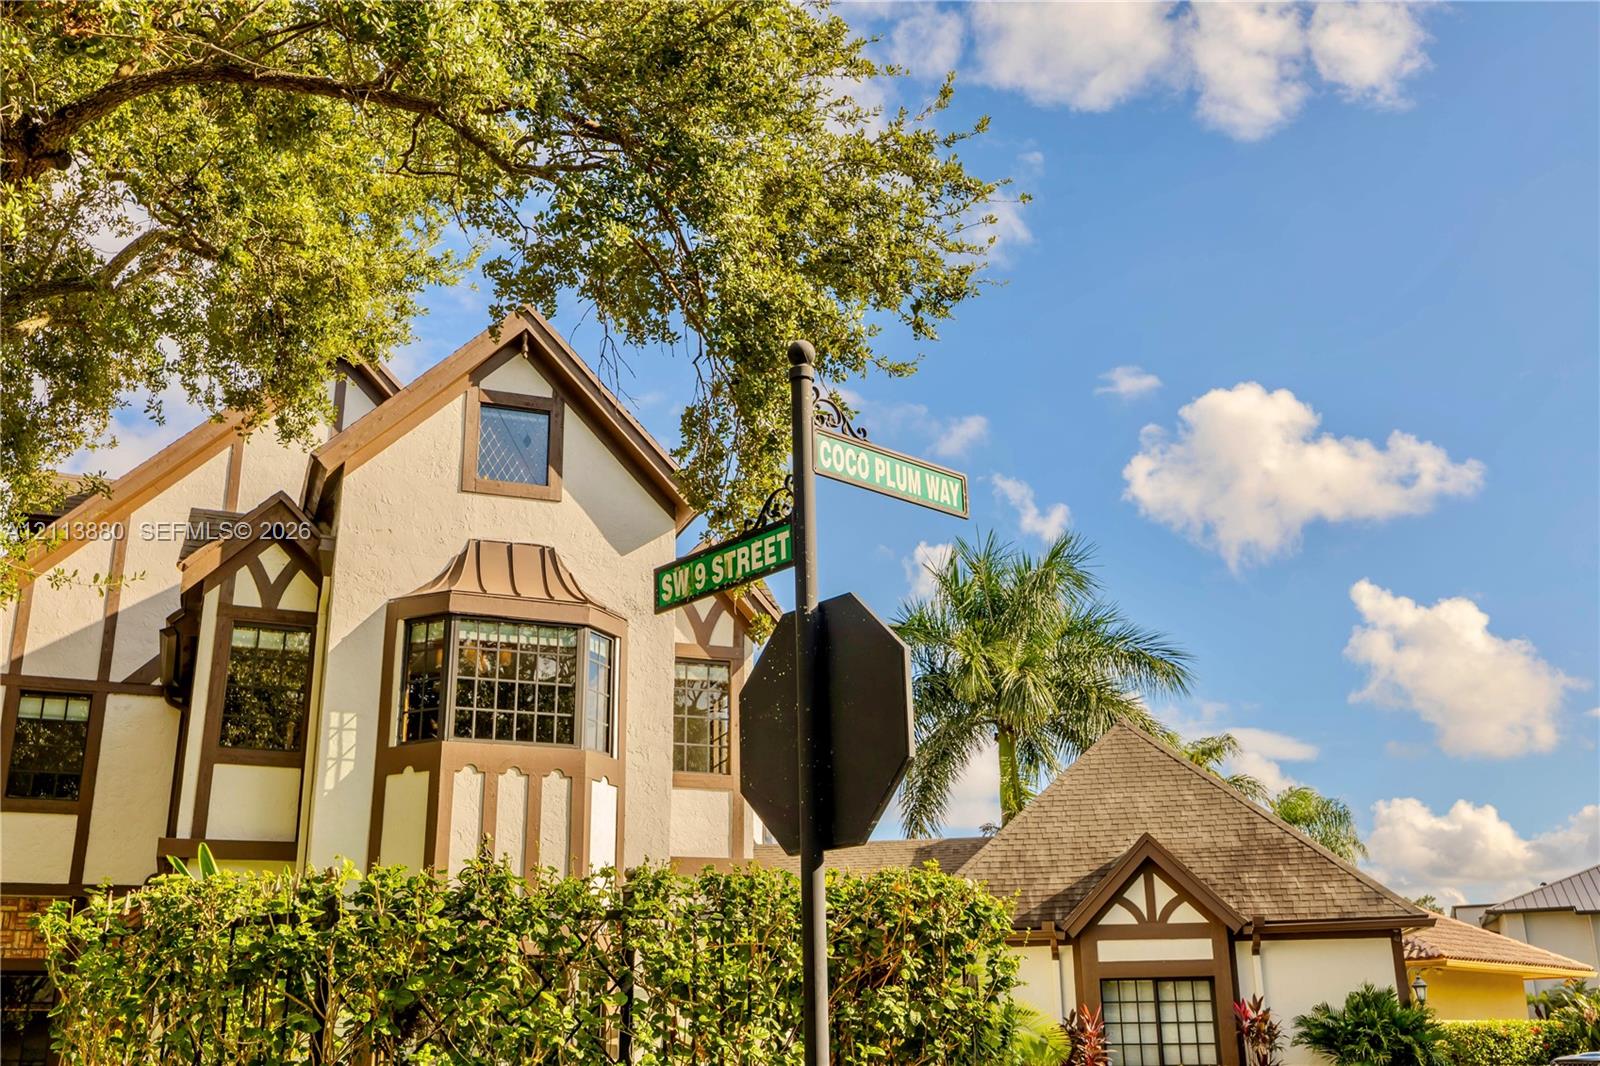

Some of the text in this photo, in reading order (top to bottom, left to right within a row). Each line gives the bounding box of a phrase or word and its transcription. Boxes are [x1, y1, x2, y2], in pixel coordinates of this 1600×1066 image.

[820, 439, 961, 507] COCO PLUM WAY
[661, 530, 791, 602] SW 9 STREET
